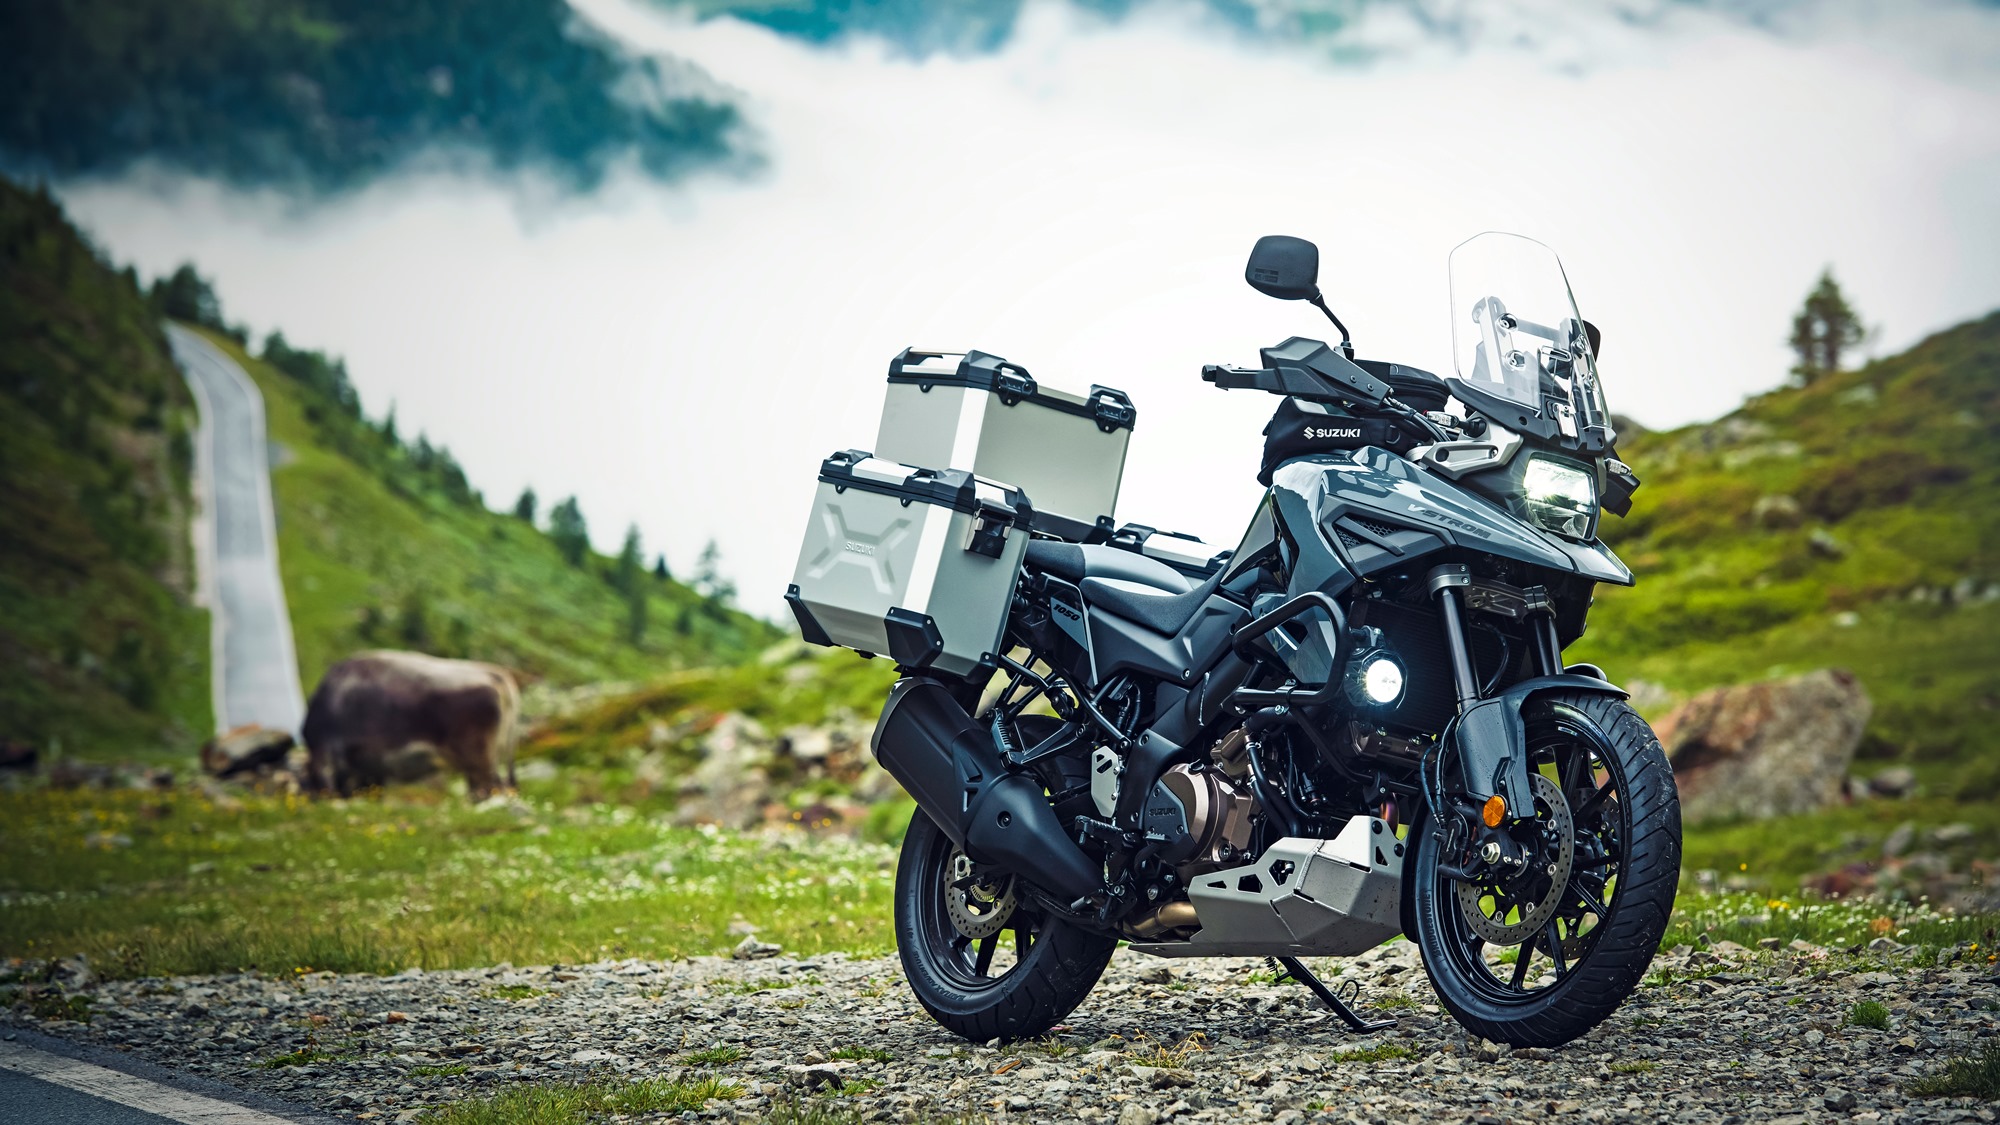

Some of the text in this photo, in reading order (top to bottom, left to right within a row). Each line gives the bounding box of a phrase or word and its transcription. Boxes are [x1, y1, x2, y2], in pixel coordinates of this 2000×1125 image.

[1316, 428, 1361, 438] SUZUKI
[1407, 503, 1491, 539] V-STROM
[845, 541, 876, 557] SUZUKI
[1053, 604, 1080, 621] 1050
[1149, 807, 1177, 817] SUZUKI
